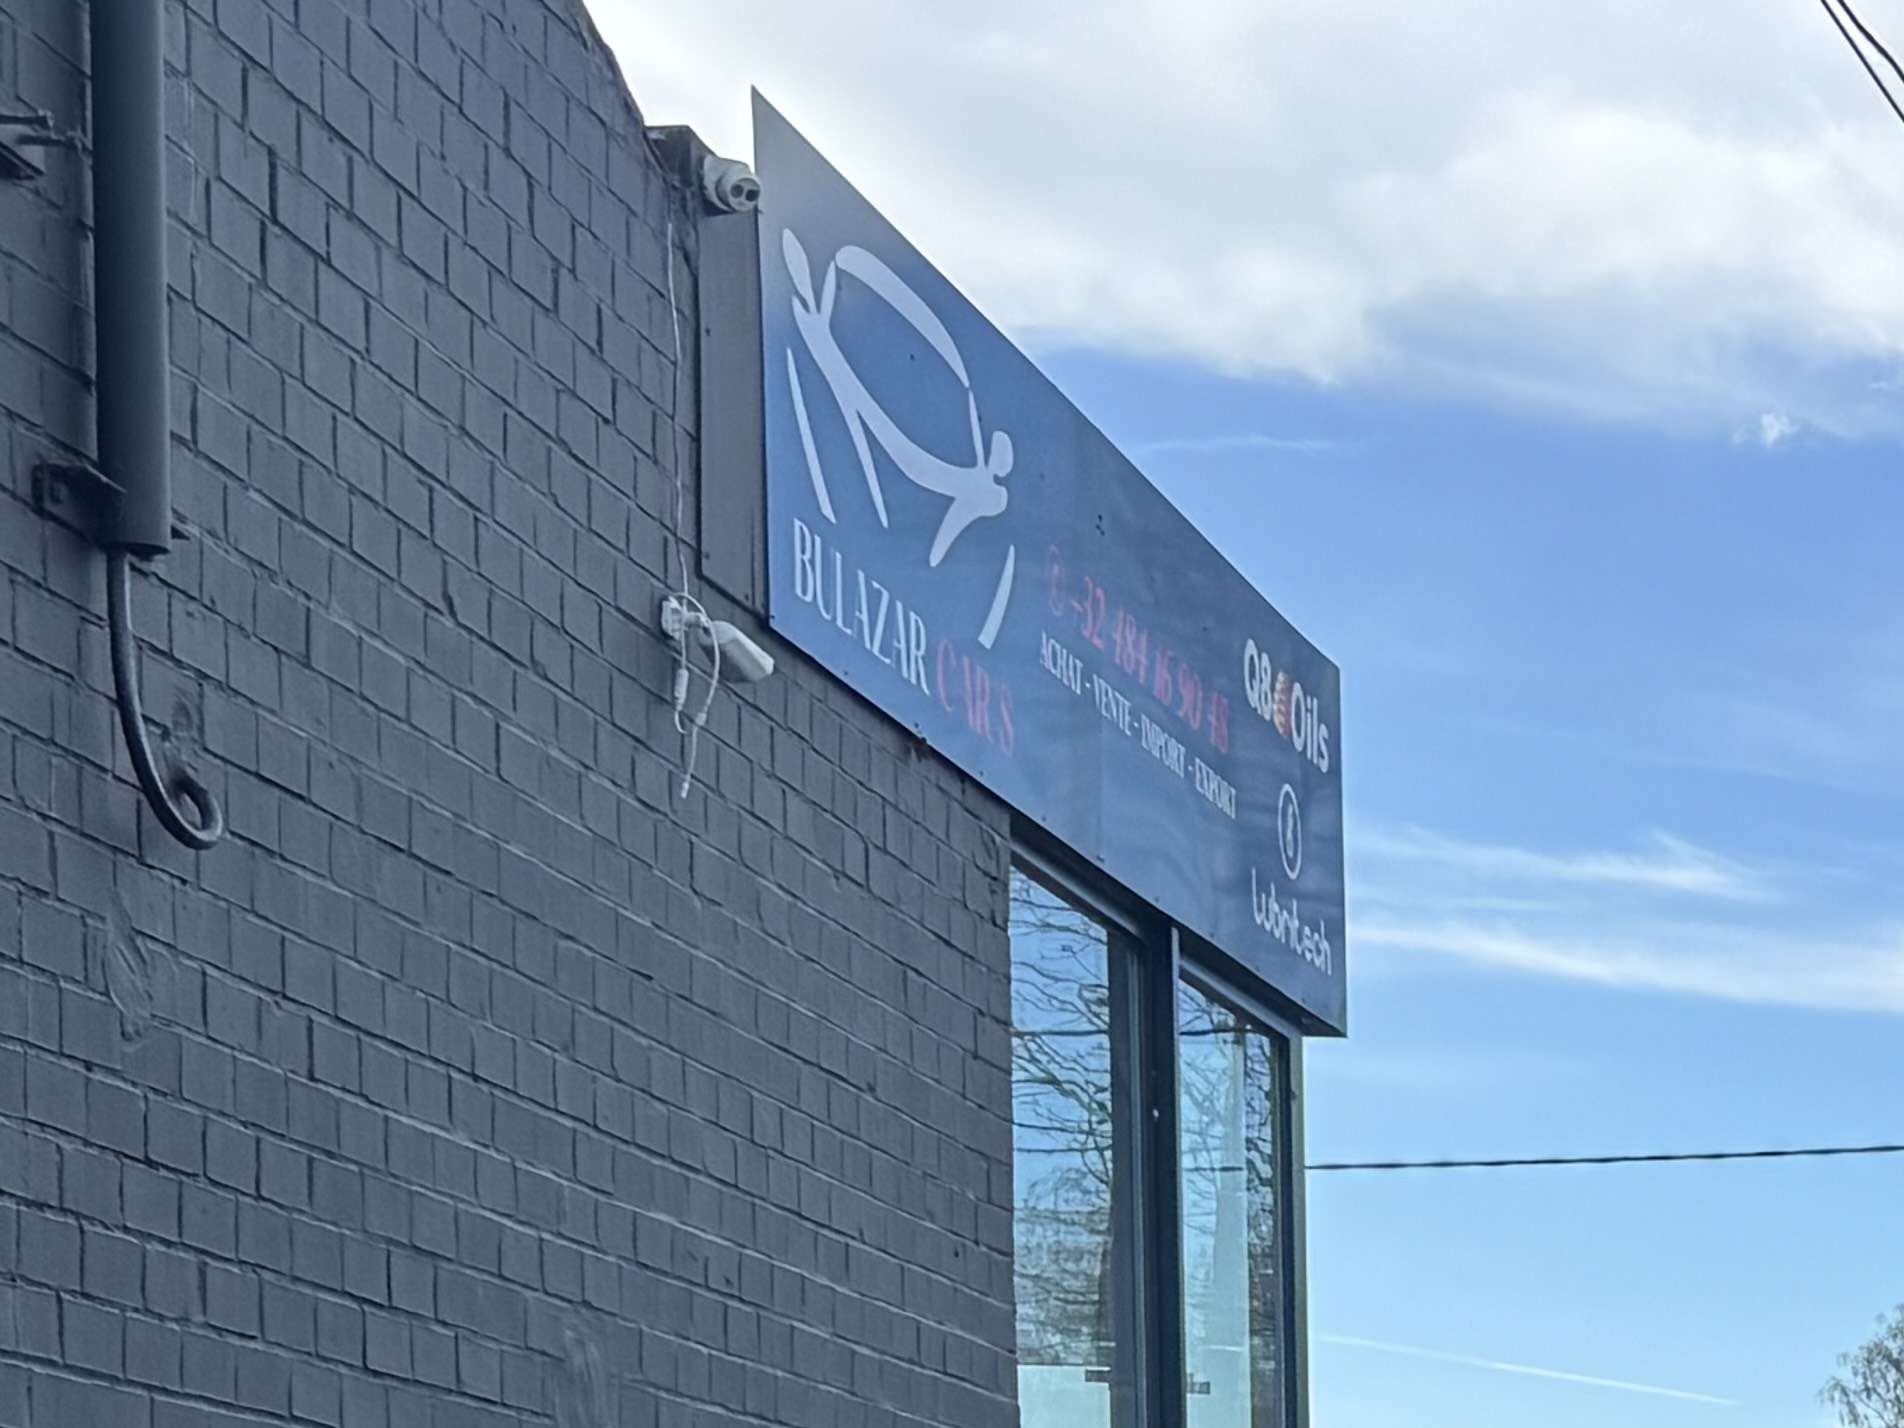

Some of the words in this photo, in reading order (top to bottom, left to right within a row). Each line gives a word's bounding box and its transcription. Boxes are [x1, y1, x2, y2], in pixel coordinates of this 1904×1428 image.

[793, 517, 931, 696] BULAZAR
[1039, 630, 1084, 695] ACHAT
[1092, 673, 1132, 737] VENTE
[1140, 713, 1186, 779] IMPORT
[1194, 756, 1237, 820] EXPORT
[1243, 638, 1272, 721] Q8
[1290, 681, 1330, 773] Oils
